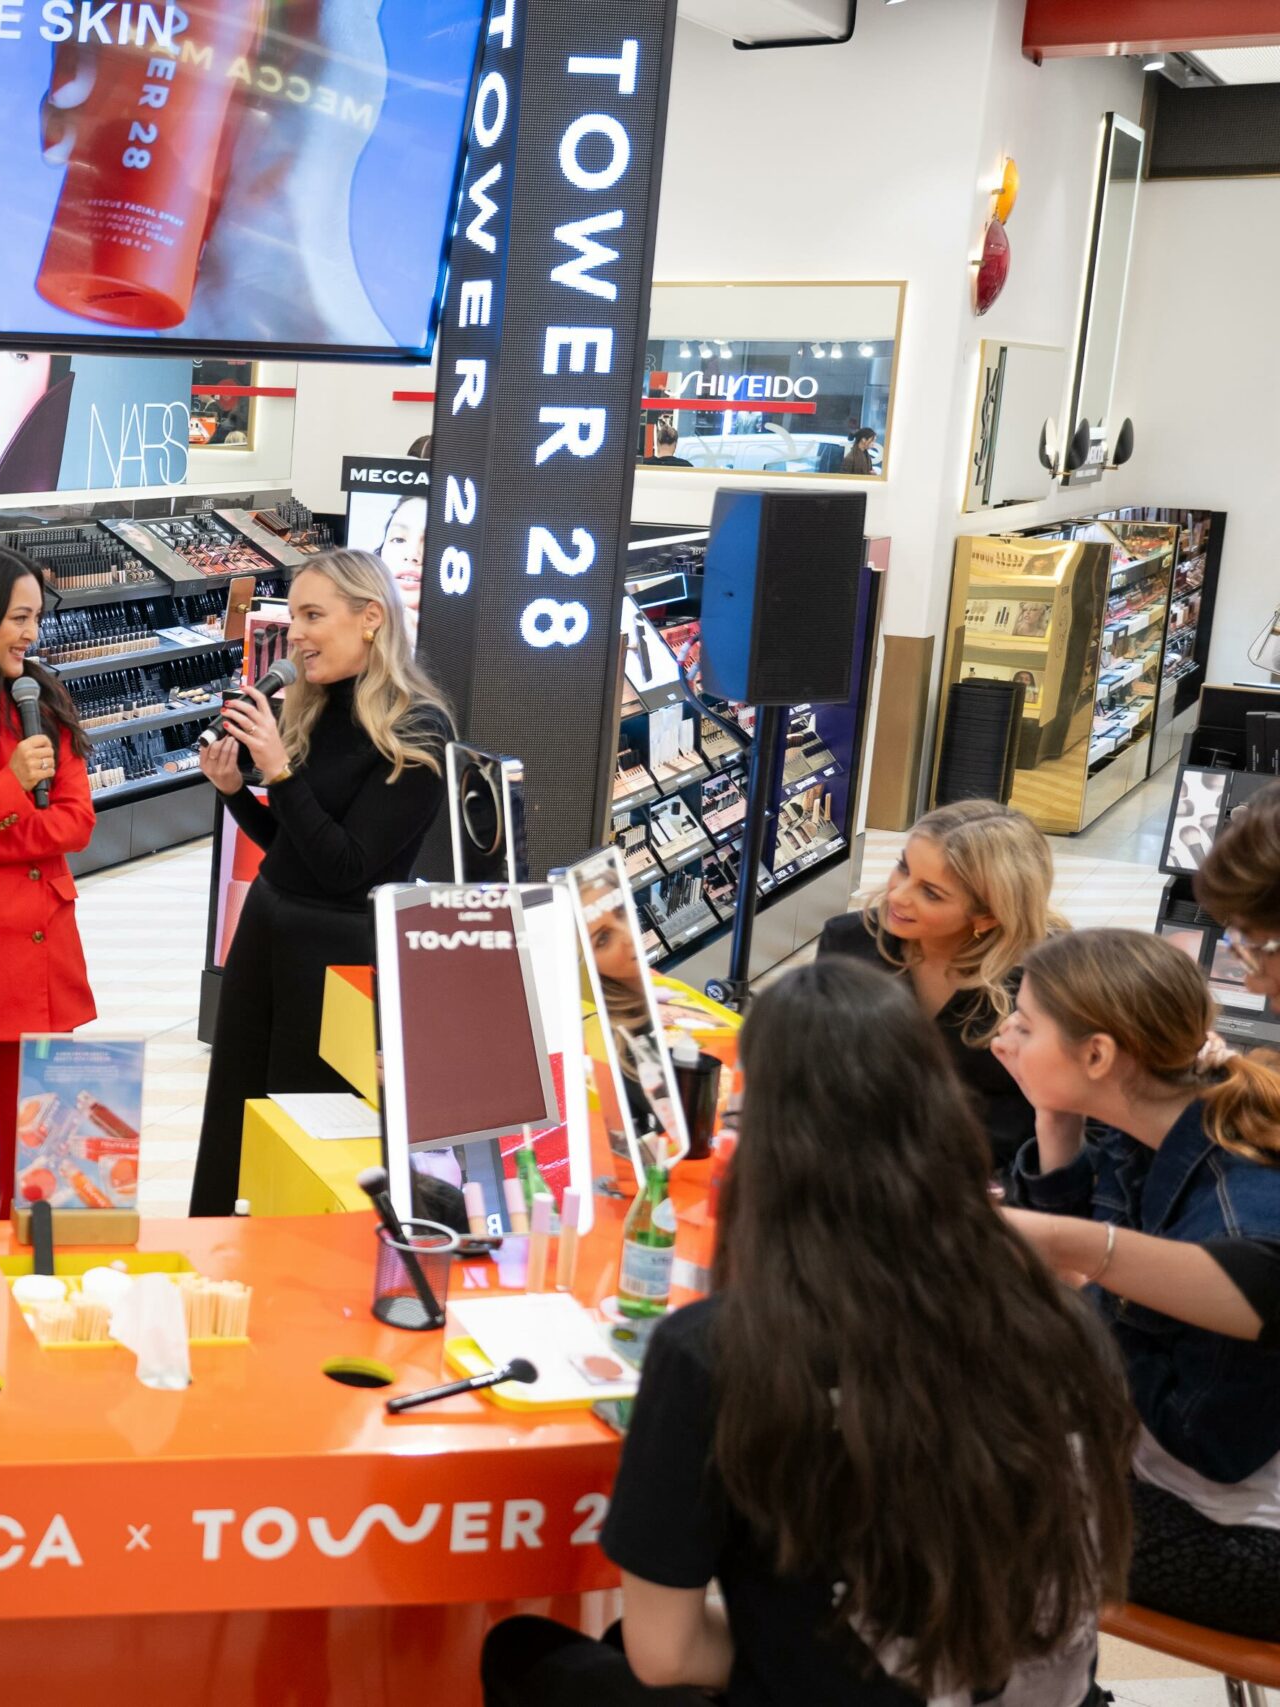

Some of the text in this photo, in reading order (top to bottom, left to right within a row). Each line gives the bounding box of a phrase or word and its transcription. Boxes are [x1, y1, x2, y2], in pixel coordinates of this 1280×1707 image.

[39, 0, 174, 47] SKIN
[122, 121, 158, 170] 28
[106, 211, 163, 231] PROTECTEUR
[124, 199, 157, 218] FACIAL
[158, 211, 185, 228] SPRAY
[106, 221, 131, 232] POUR
[132, 226, 144, 236] LE
[145, 230, 174, 247] VISAGE
[439, 0, 516, 596] TOWER 28
[520, 38, 639, 648] TOWER 28
[664, 370, 819, 399] SHISEIDO
[87, 401, 191, 490] NARS
[349, 467, 429, 487] MECCA
[430, 888, 518, 909] MECCA
[404, 930, 513, 950] TOWER
[190, 1499, 547, 1562] TOWER
[569, 1491, 611, 1546] 2
